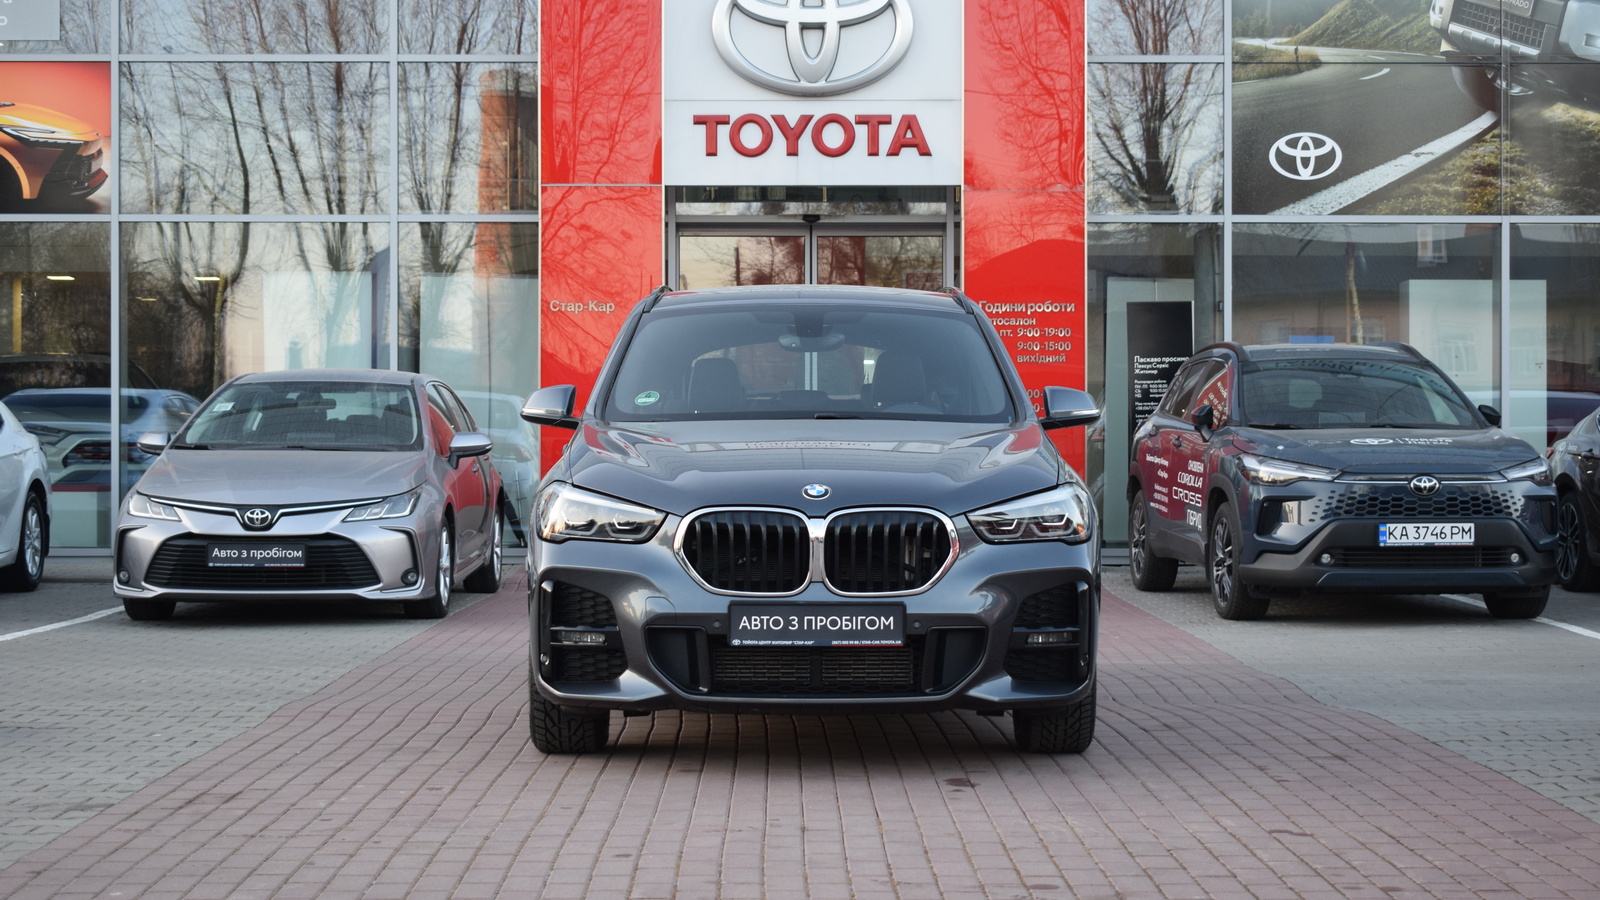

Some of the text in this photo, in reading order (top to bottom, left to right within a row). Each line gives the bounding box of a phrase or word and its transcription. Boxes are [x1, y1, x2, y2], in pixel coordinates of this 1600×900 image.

[693, 113, 932, 158] TOYOTA
[549, 300, 615, 314] Стар-Кар
[979, 300, 1075, 315] Години роботи
[1017, 353, 1066, 364] вихідний
[1177, 471, 1203, 488] COROLLA
[1172, 486, 1202, 507] CROSS
[1413, 526, 1447, 540] 3746
[212, 547, 302, 560] Авто з пробігом
[738, 615, 784, 630] АВТО
[804, 615, 894, 630] ПРОБІГОМ
